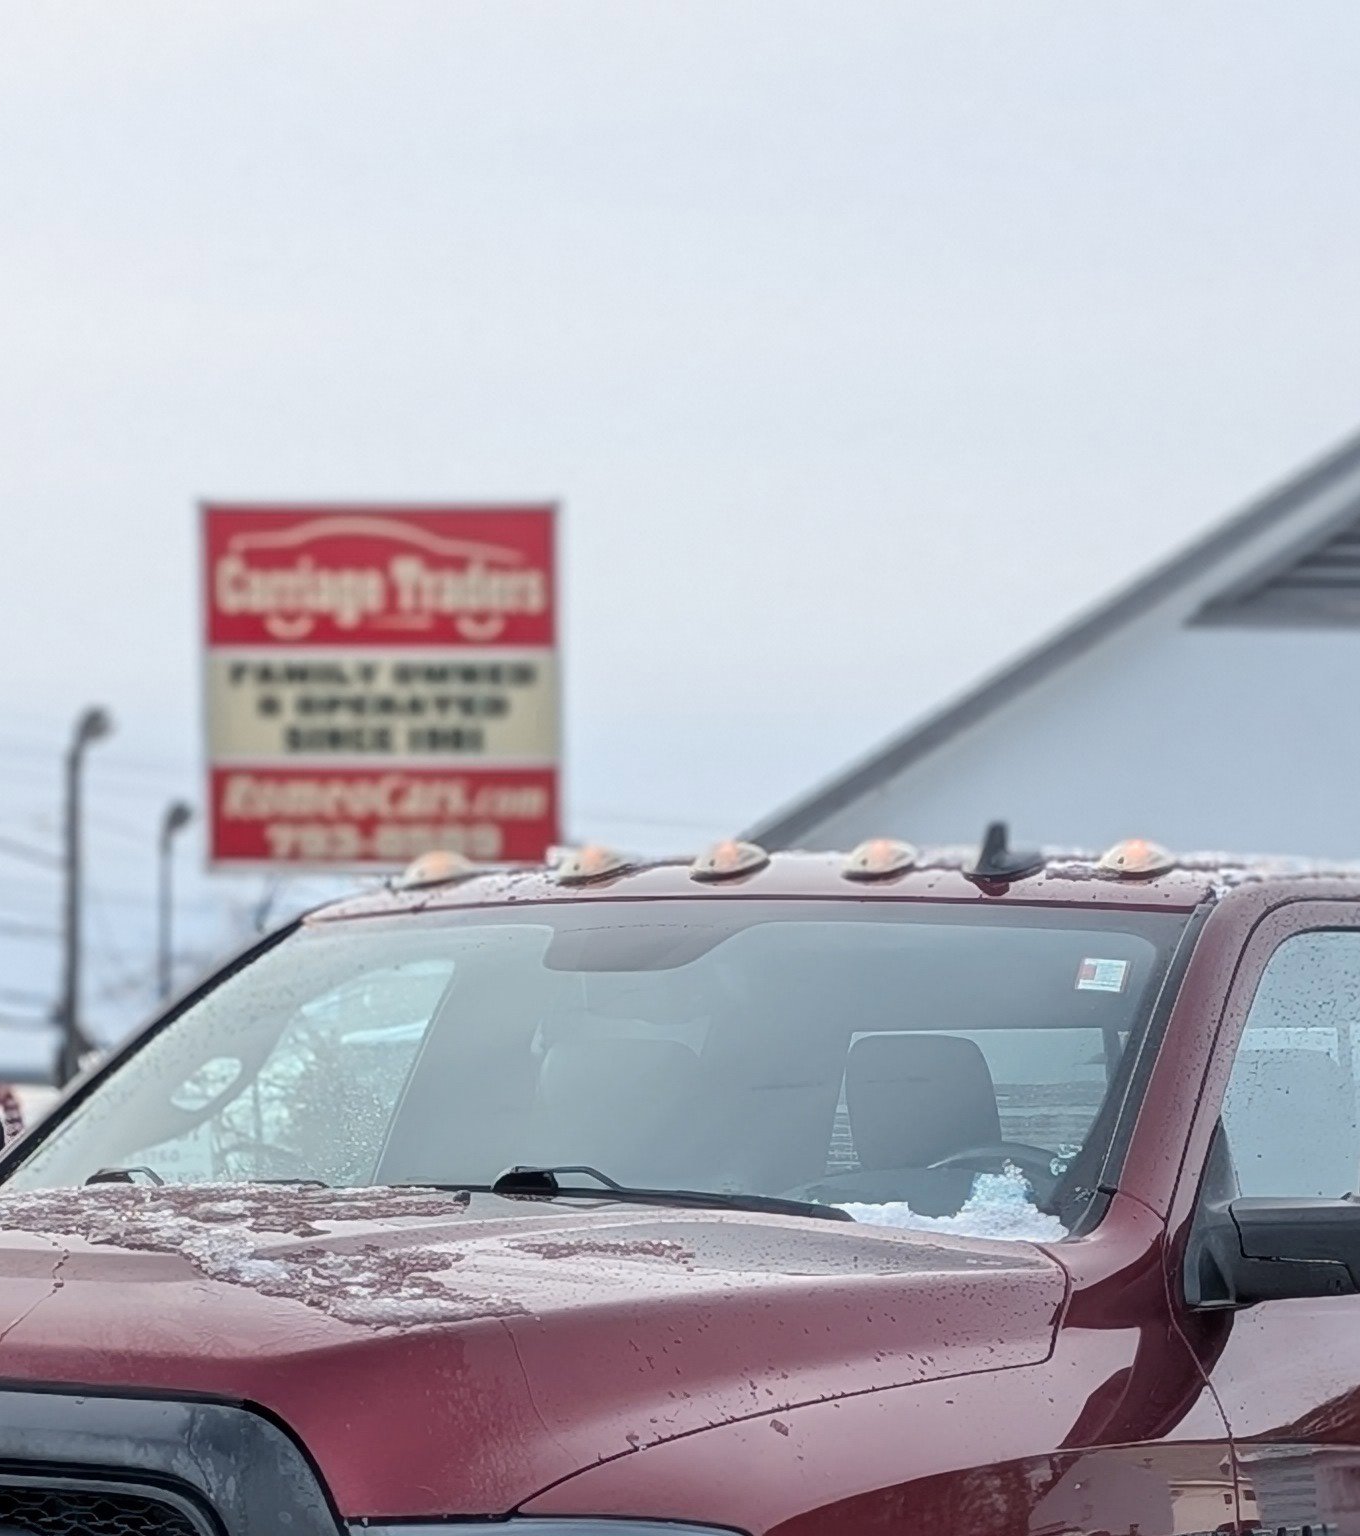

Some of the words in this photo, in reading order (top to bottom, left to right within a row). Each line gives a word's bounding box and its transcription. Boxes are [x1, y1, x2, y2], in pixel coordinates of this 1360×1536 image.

[216, 554, 384, 629] Carriage
[389, 556, 545, 614] Traders
[229, 662, 376, 685] FAMILY
[392, 662, 536, 686] OWNED
[257, 694, 281, 717] &
[295, 694, 509, 718] OPERATED
[285, 727, 392, 752] SINCE
